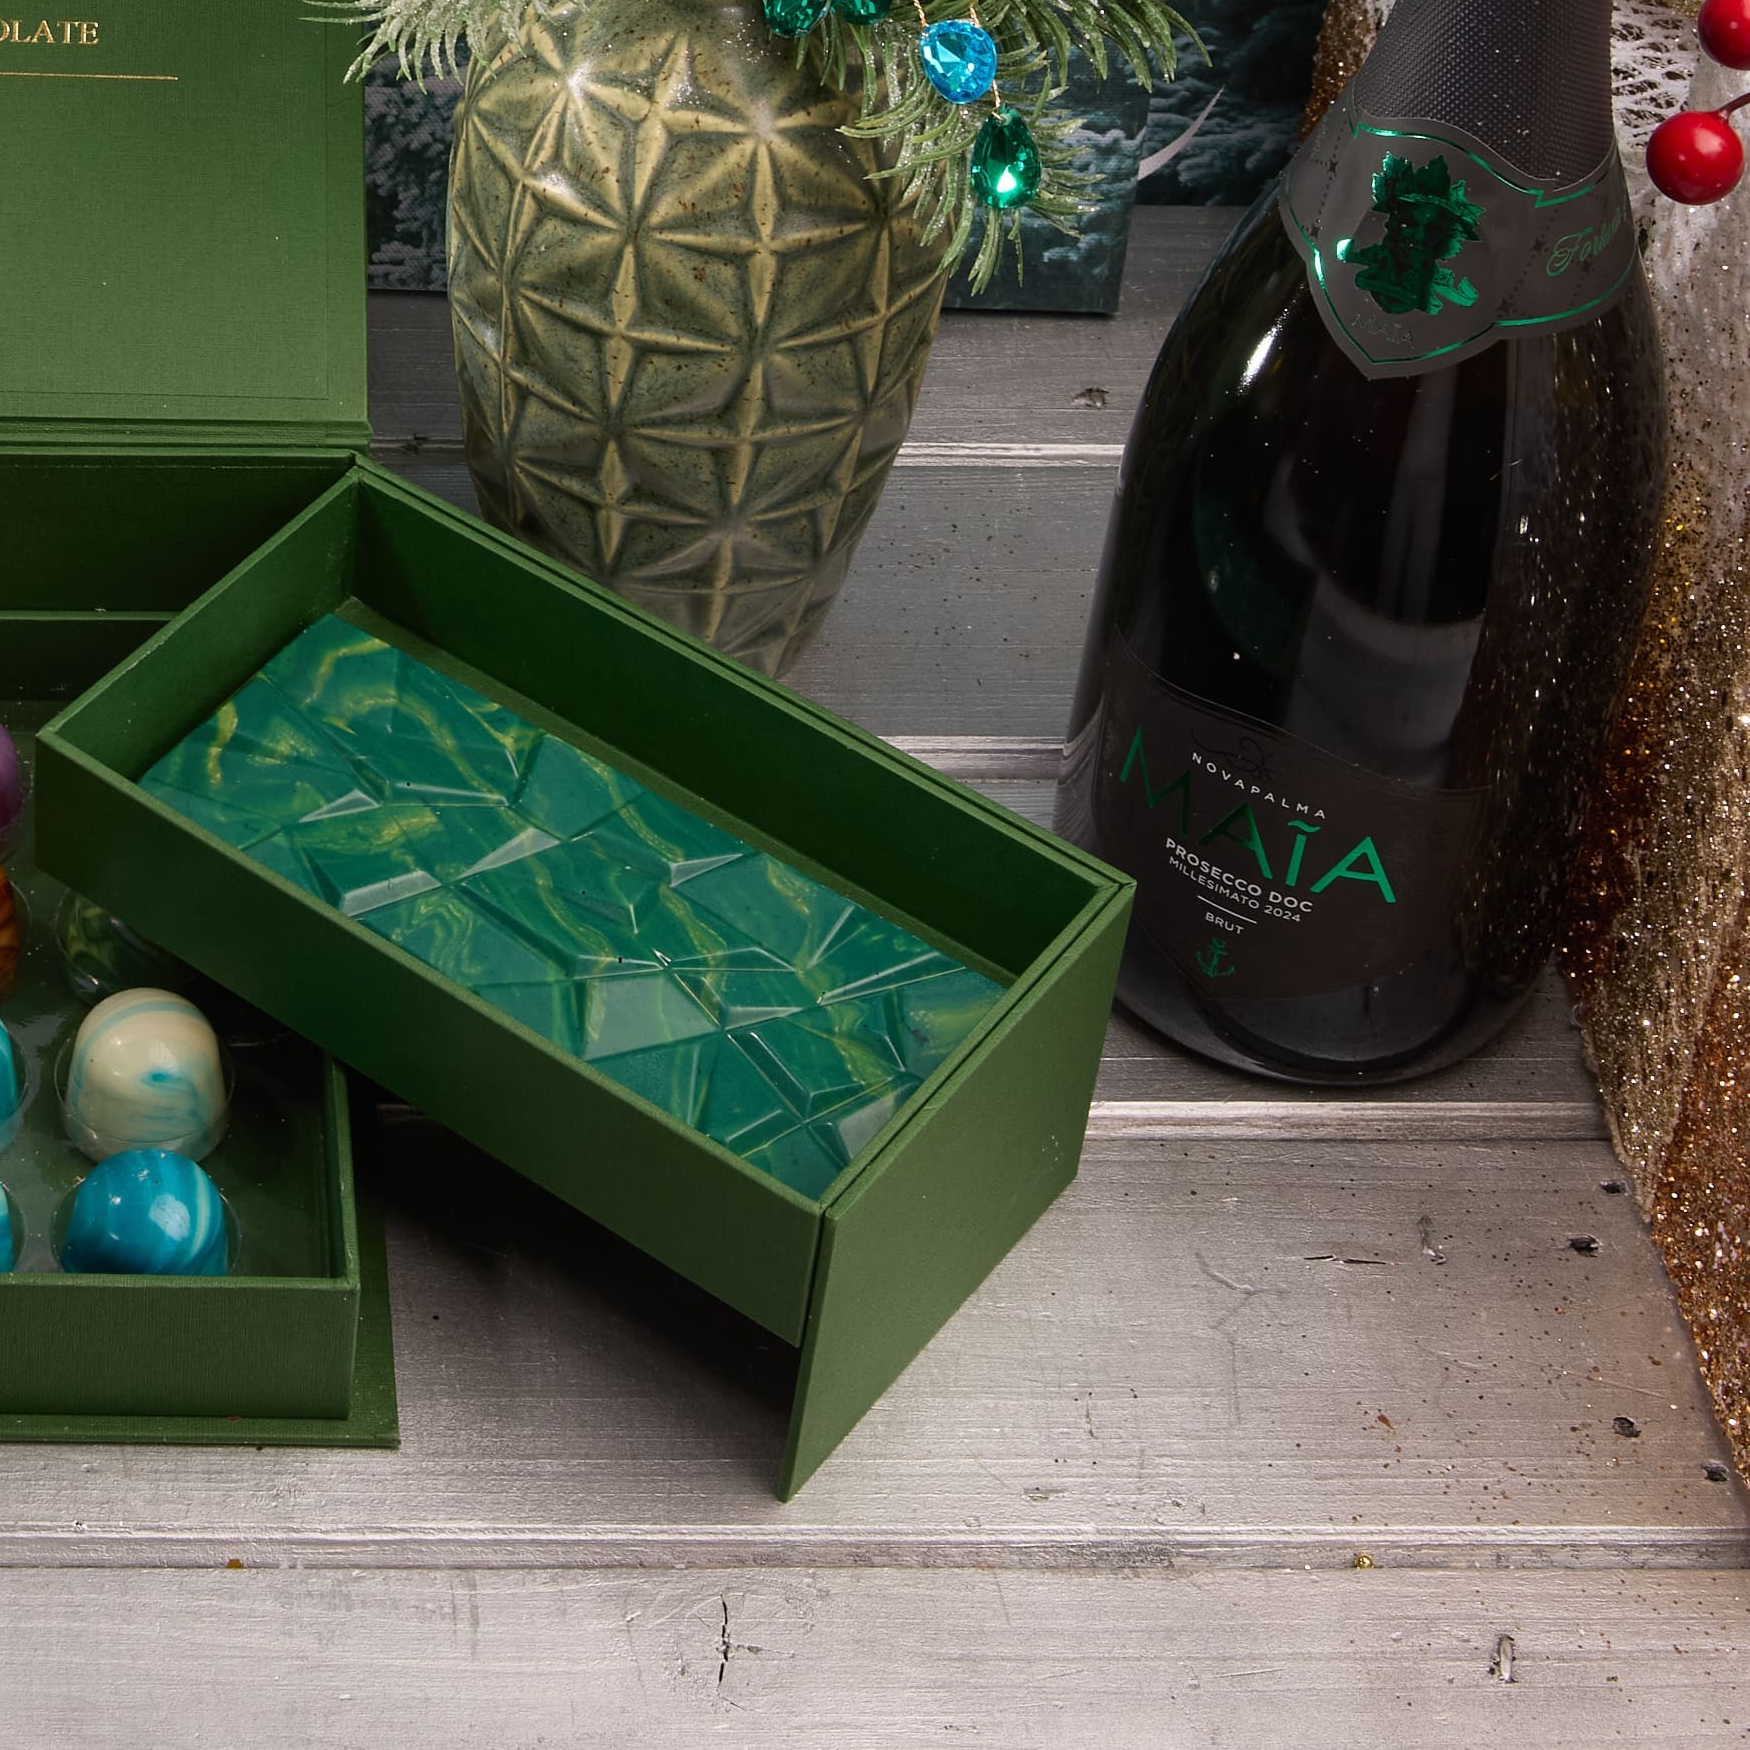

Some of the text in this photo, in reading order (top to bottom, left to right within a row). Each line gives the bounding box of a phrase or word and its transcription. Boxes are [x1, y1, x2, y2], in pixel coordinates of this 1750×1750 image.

[1191, 752, 1327, 820] NOVAPALMA
[1165, 837, 1314, 914] PROSECCO DOC
[1168, 856, 1302, 923] MILLESIMATO 2024
[1205, 911, 1245, 935] BRUT
